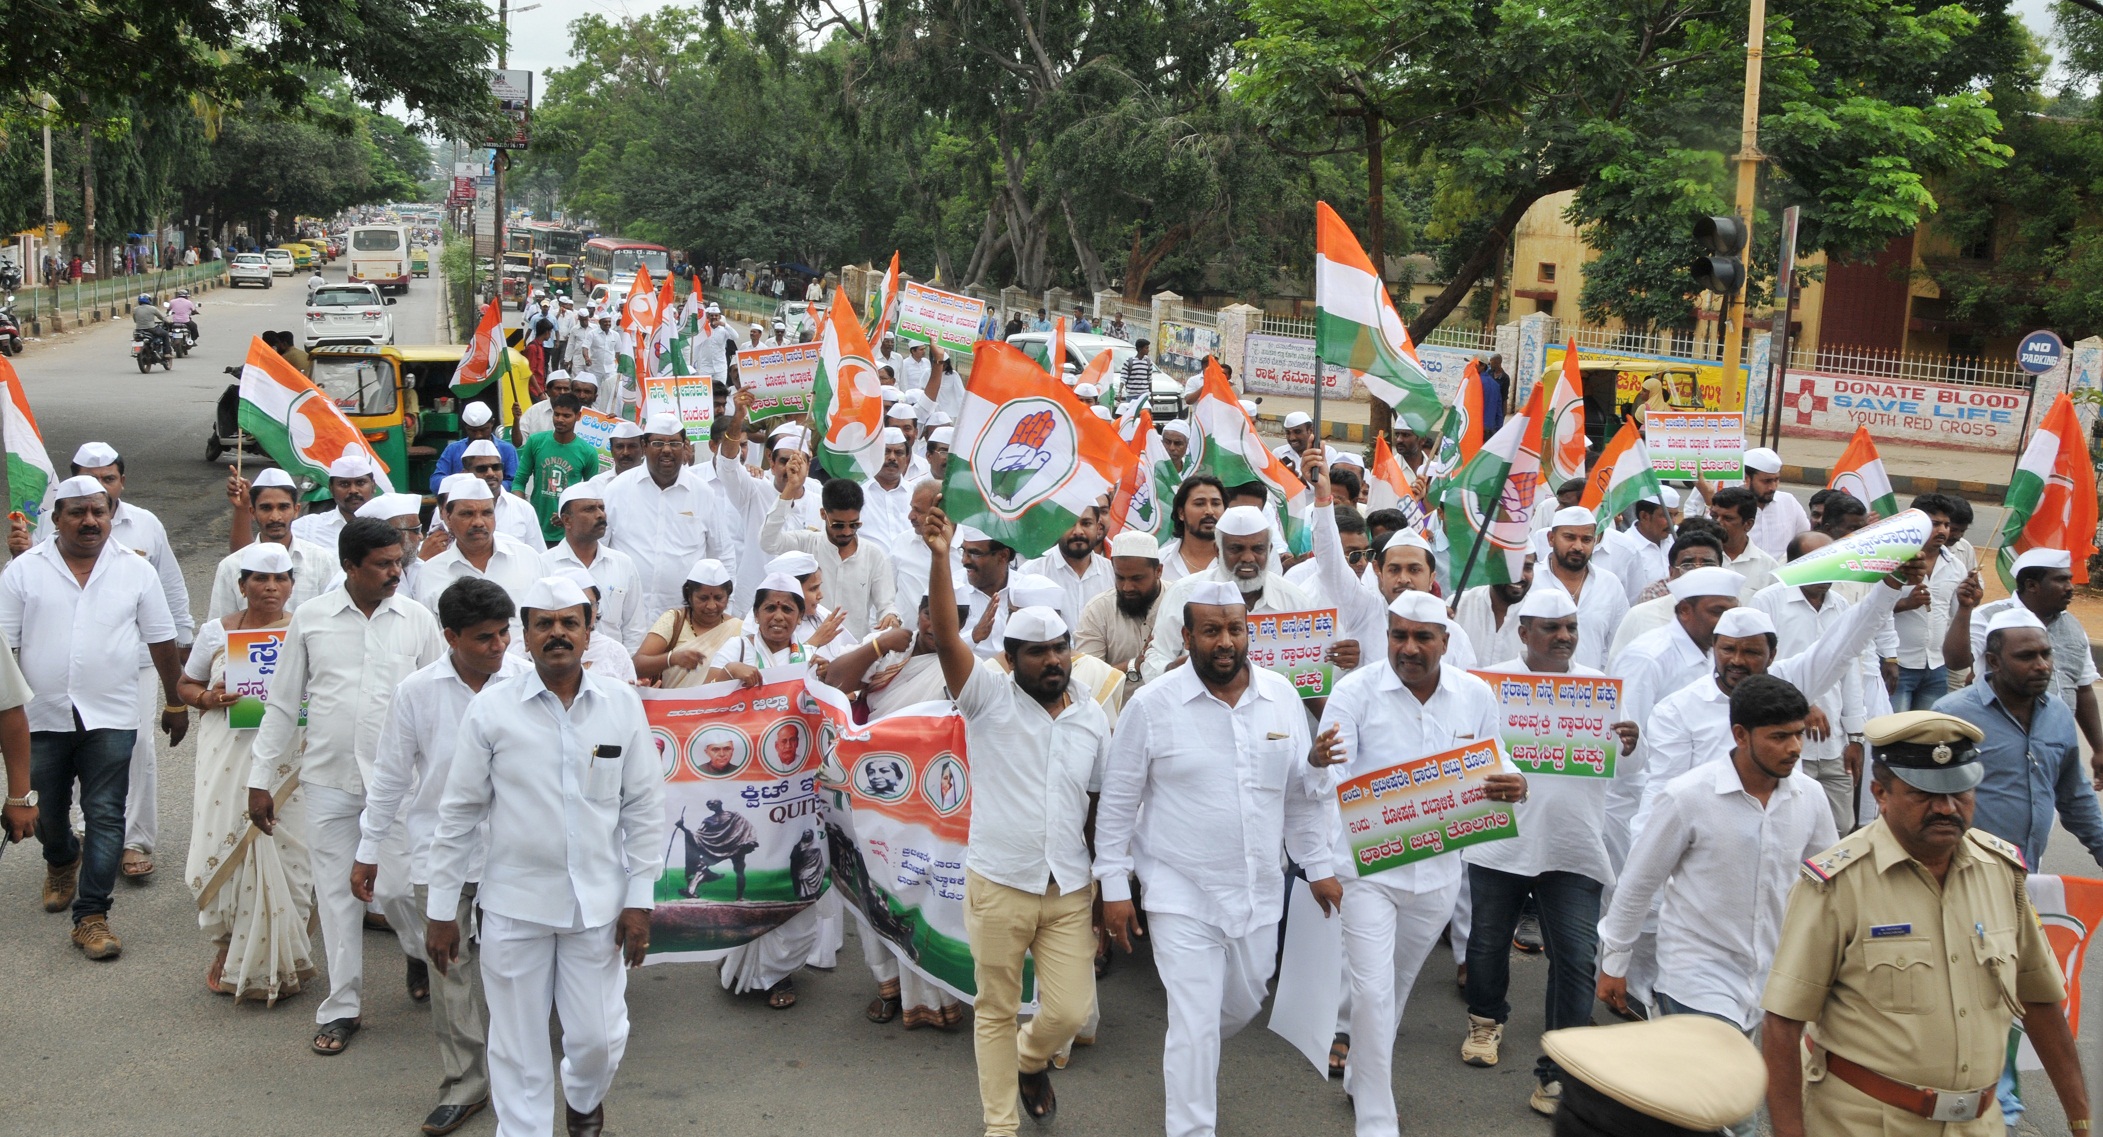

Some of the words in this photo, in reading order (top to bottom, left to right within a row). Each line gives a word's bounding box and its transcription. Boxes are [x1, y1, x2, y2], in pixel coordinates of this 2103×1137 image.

[2028, 342, 2051, 352] NO
[2021, 353, 2059, 366] PARKING
[1255, 367, 1279, 384] ರಾಜ್ಯ
[1834, 380, 1926, 401] DONATE
[1937, 390, 2019, 410] BLOOD
[683, 406, 710, 421] ಸಂದೇಶ
[1834, 395, 1919, 415] SAVE
[1933, 404, 2011, 423] LIFE
[1848, 410, 1896, 428] YOUTH
[1903, 416, 1933, 431] RED
[1940, 420, 1997, 437] CROSS
[541, 456, 573, 472] LONDON
[1652, 457, 1676, 471] ಭಾರತ
[1701, 457, 1740, 470] ತೊಲಗಲಿ
[1315, 613, 1333, 637] ಹಕ್ಕು
[1295, 670, 1323, 692] ಹಕ್ಕು
[752, 695, 790, 713] ಜಿಲ್ಲಾ
[1536, 680, 1554, 706] ನನ್ನ
[1597, 682, 1617, 709] ಹಕ್ಕು
[1508, 711, 1551, 737] ಅಭಿವ್ಯಕ್ತಿ
[1413, 759, 1440, 786] ಭಾರತ
[1443, 757, 1463, 781] ಬಿಟ್ಟು
[1464, 748, 1495, 770] ತೊಲಗಿ
[1573, 745, 1605, 774] ಹಕ್ಕು
[740, 781, 789, 809] ಕ್ವಿಟ್
[1349, 814, 1371, 834] ಇಂದು
[1359, 836, 1405, 864] ಭಾರತ
[1410, 830, 1443, 852] ಬಿಟ್ಟು
[1447, 811, 1509, 839] ತೊಲಗಲಿ
